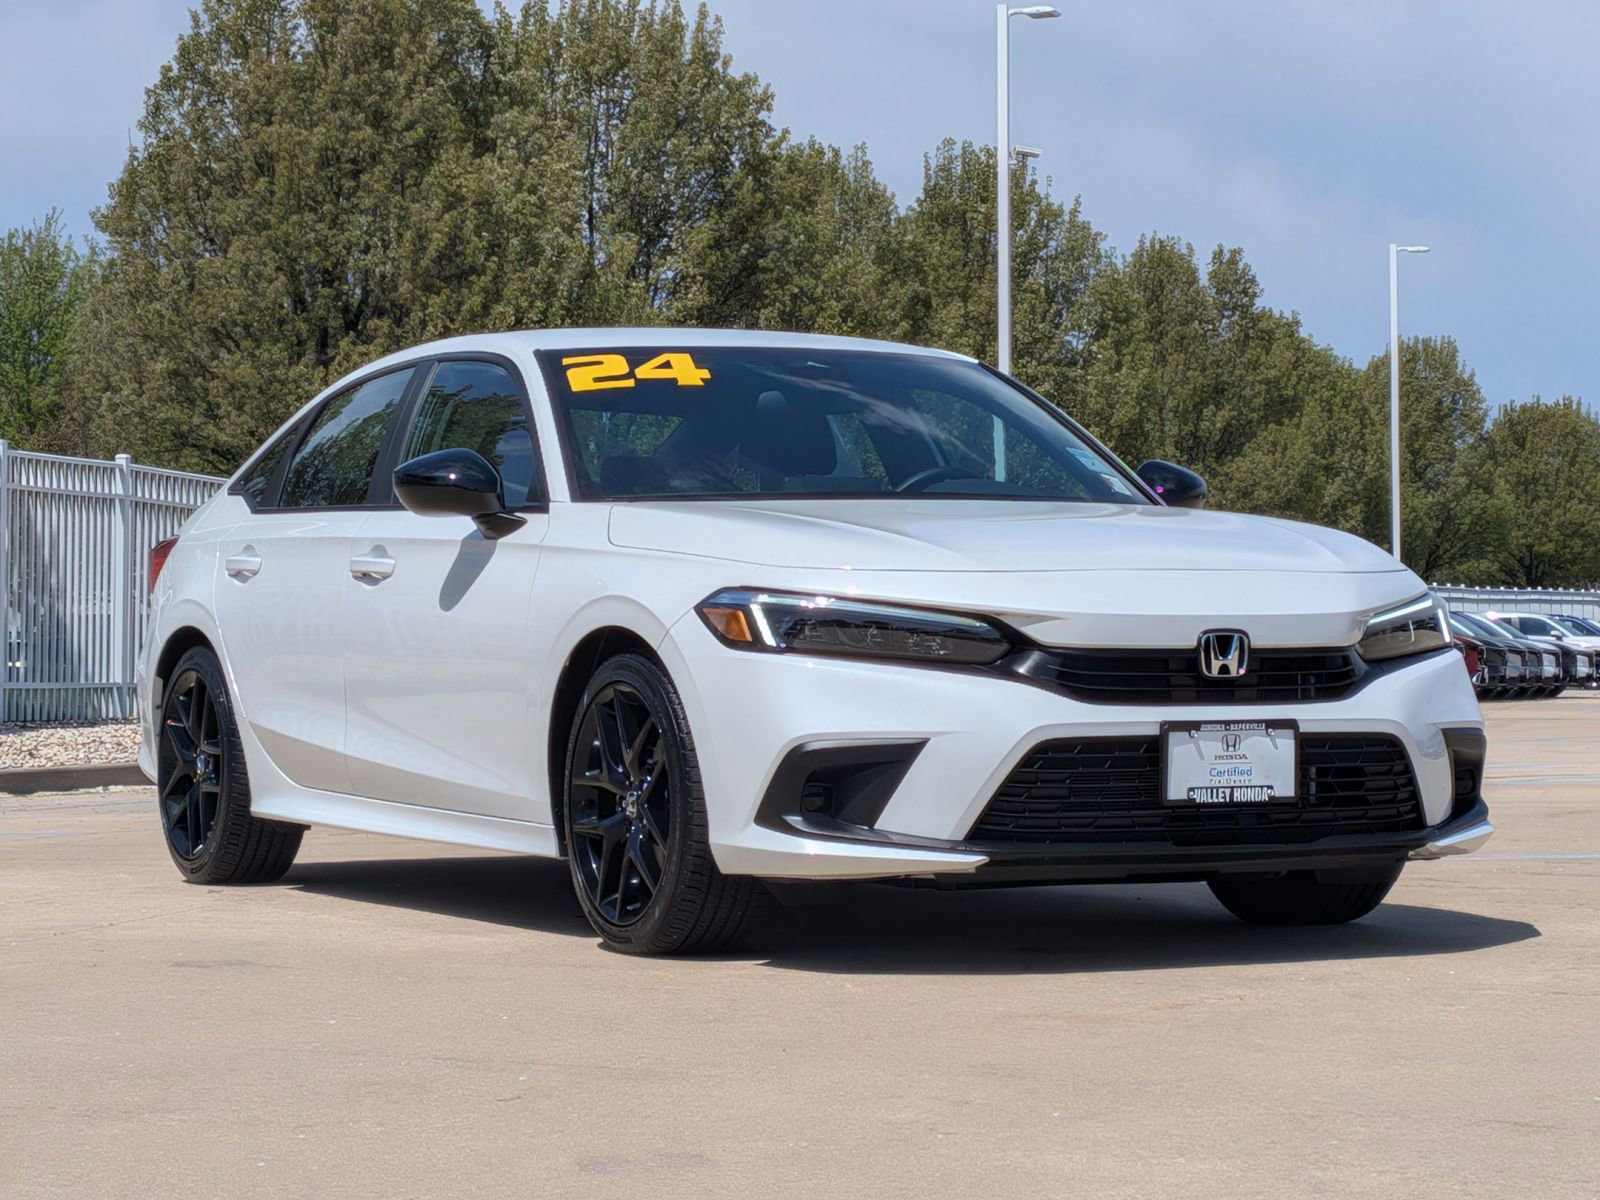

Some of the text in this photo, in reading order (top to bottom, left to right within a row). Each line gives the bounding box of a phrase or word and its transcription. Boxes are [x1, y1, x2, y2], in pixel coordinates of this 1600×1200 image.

[562, 353, 711, 392] 24
[1214, 753, 1248, 761] HONDA
[1195, 787, 1269, 803] VALLEY HONDA
